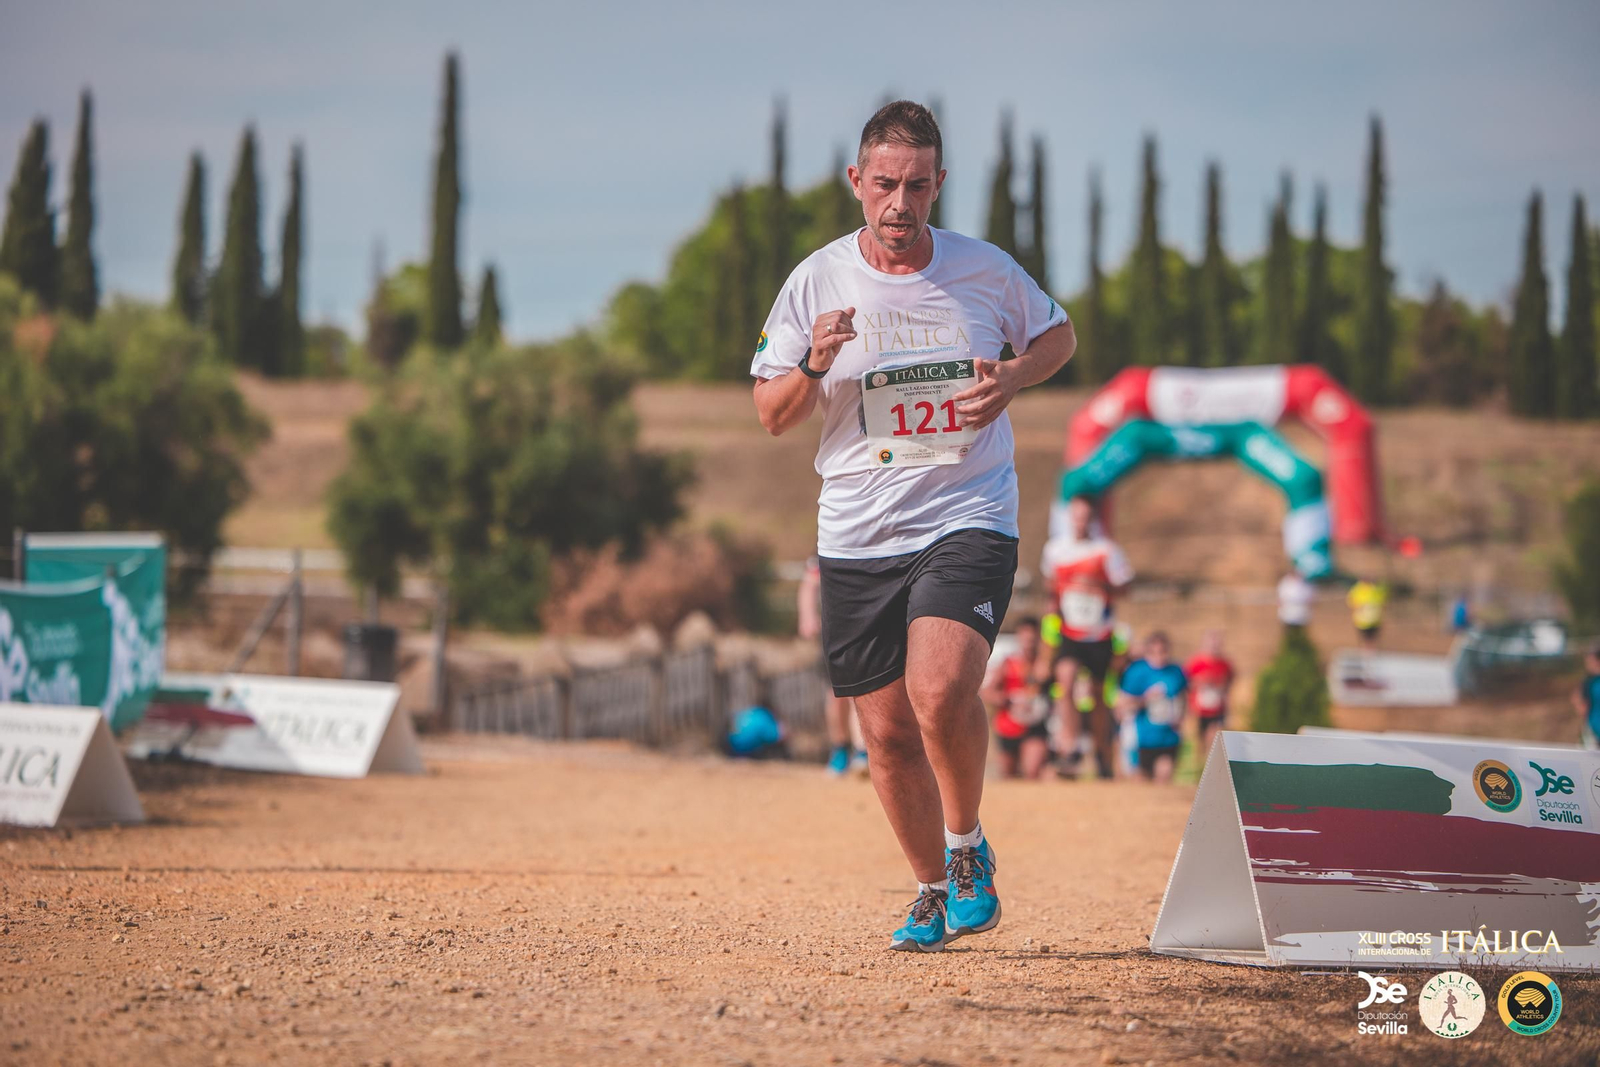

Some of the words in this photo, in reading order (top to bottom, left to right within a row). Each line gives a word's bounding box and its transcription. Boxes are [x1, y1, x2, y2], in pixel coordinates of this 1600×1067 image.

[863, 310, 910, 329] XLIII
[911, 308, 952, 320] CROSS
[863, 325, 969, 352] ITÁLICA
[895, 366, 948, 380] ITÁLICA
[890, 399, 962, 436] 121
[1536, 799, 1580, 810] Diputación
[1539, 809, 1583, 824] Sevilla
